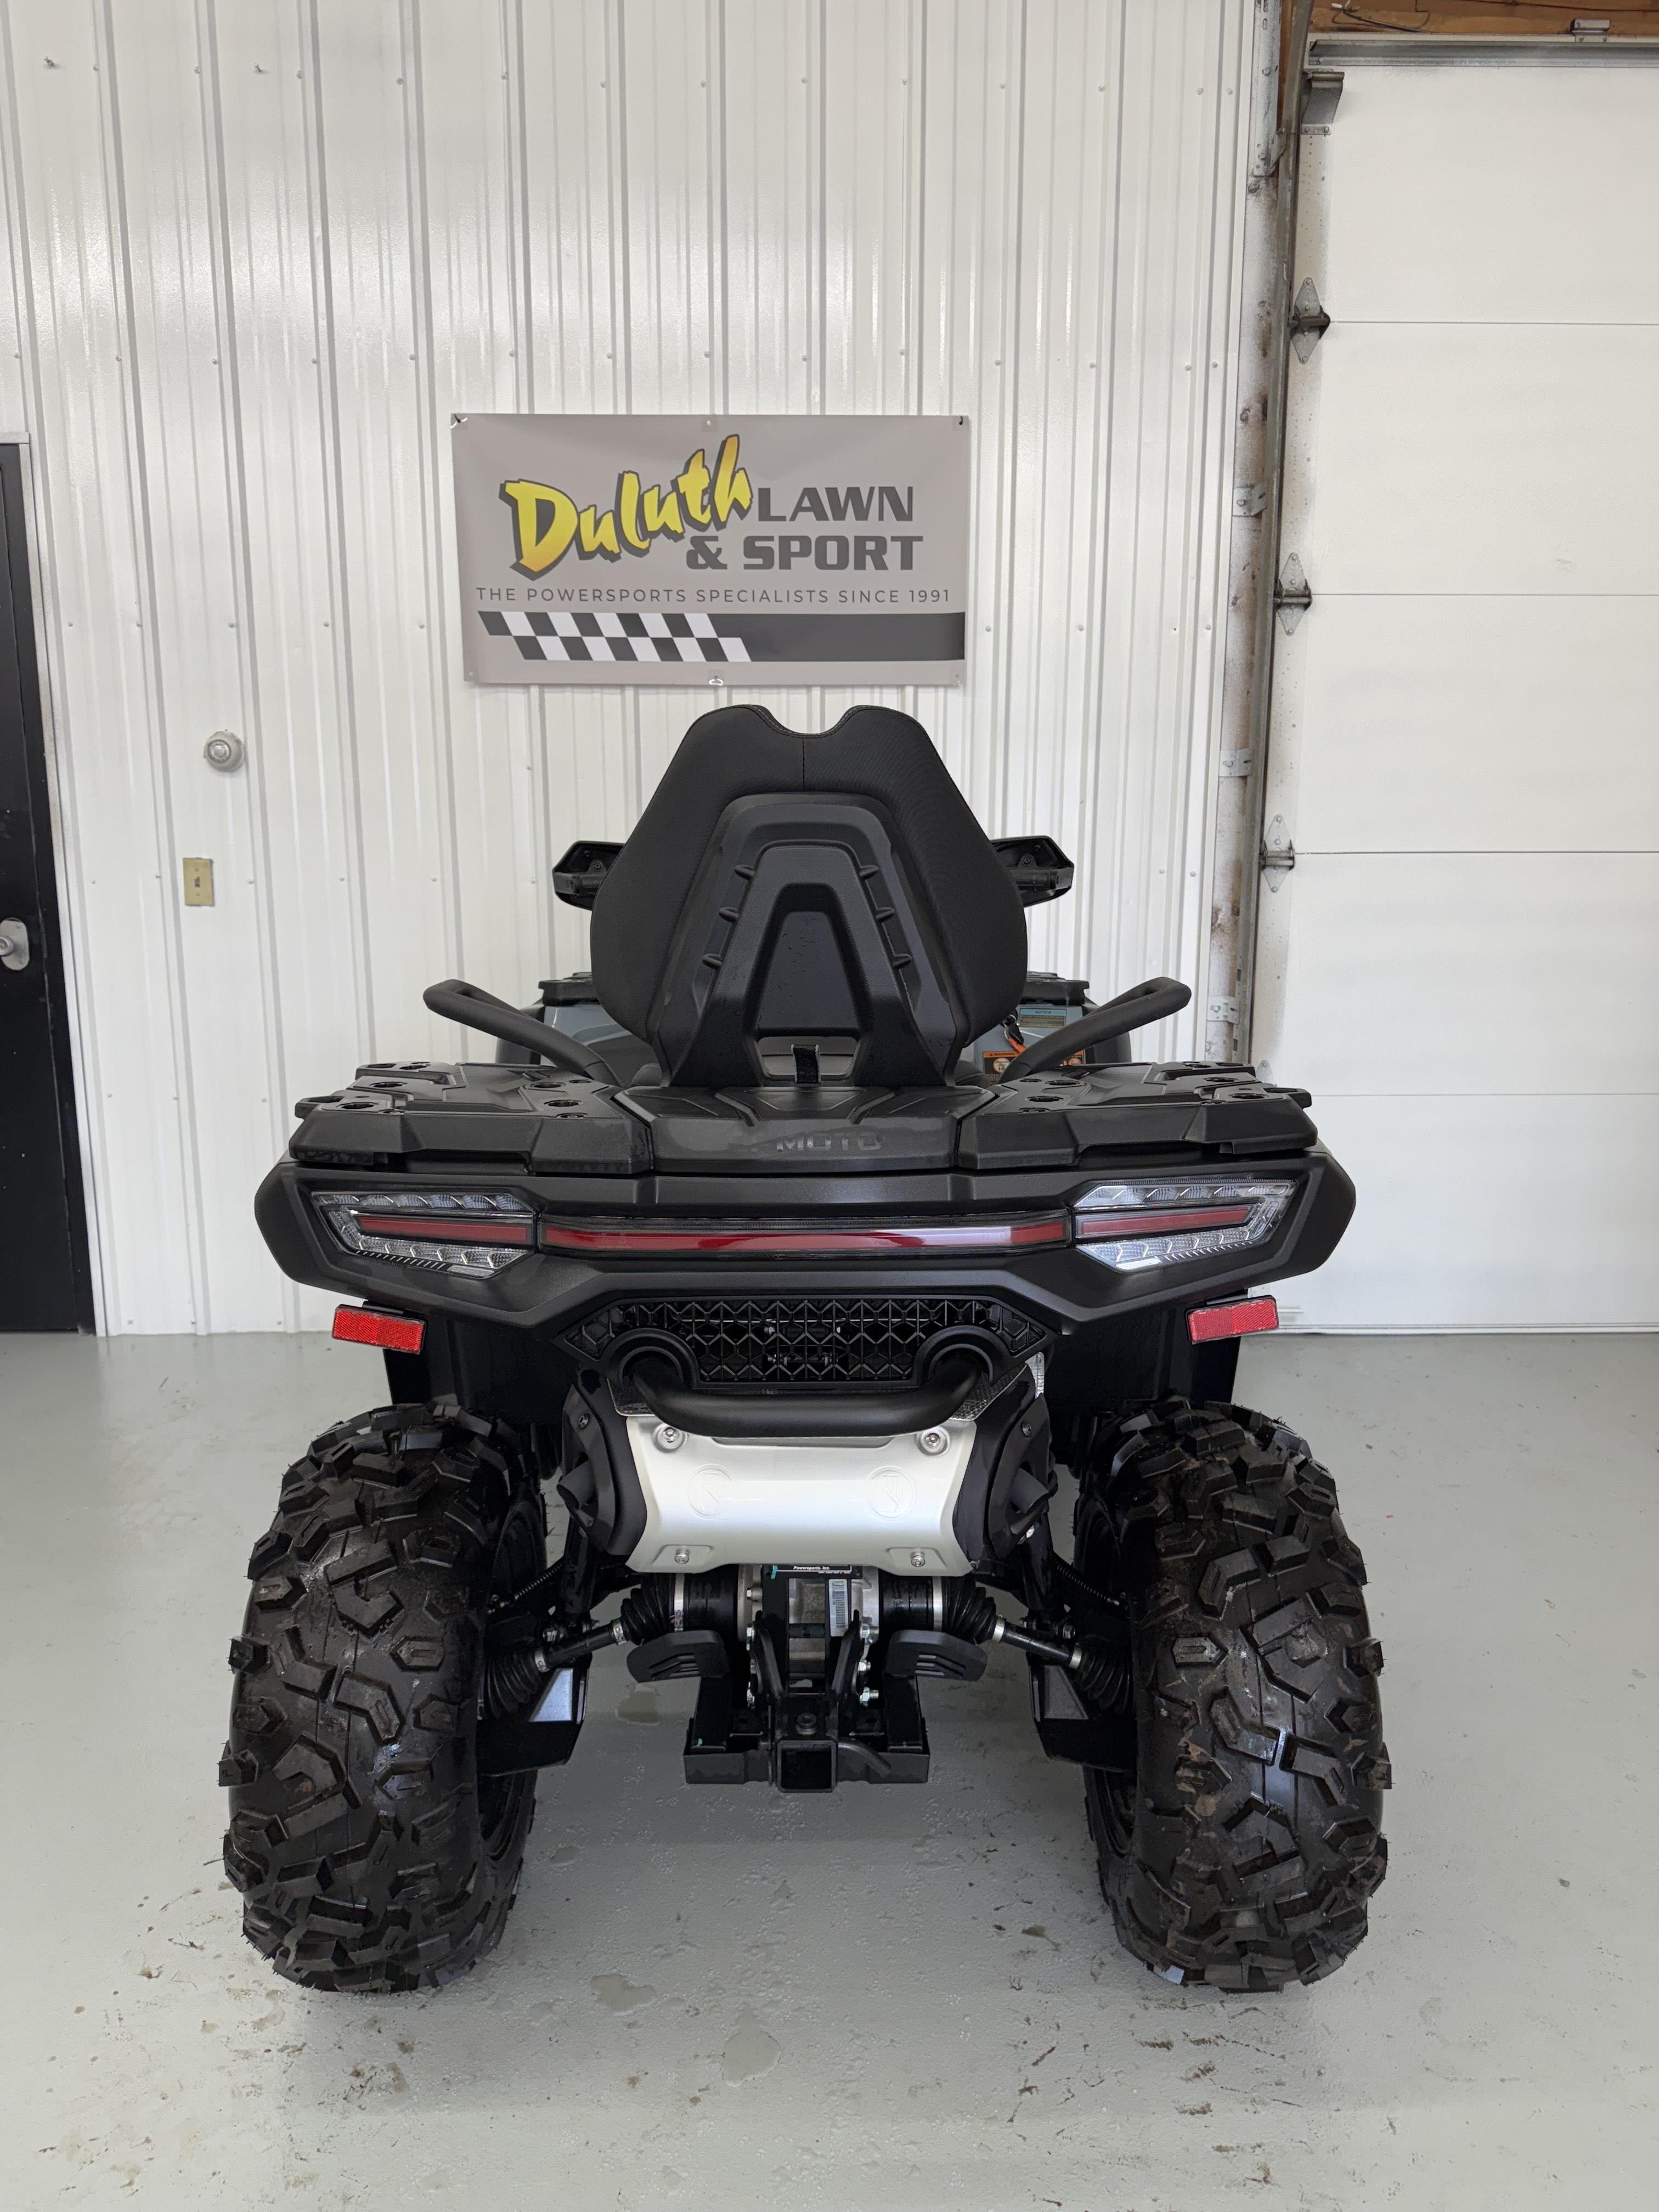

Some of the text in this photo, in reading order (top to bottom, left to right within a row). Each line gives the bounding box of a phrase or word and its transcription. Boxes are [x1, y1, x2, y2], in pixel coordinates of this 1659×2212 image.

[499, 434, 753, 580] Duluth
[758, 486, 914, 522] LAWN
[686, 535, 924, 571] & SPORT
[476, 587, 950, 604] THE POWERSPORTS SPECIALISTS SINCE 1991
